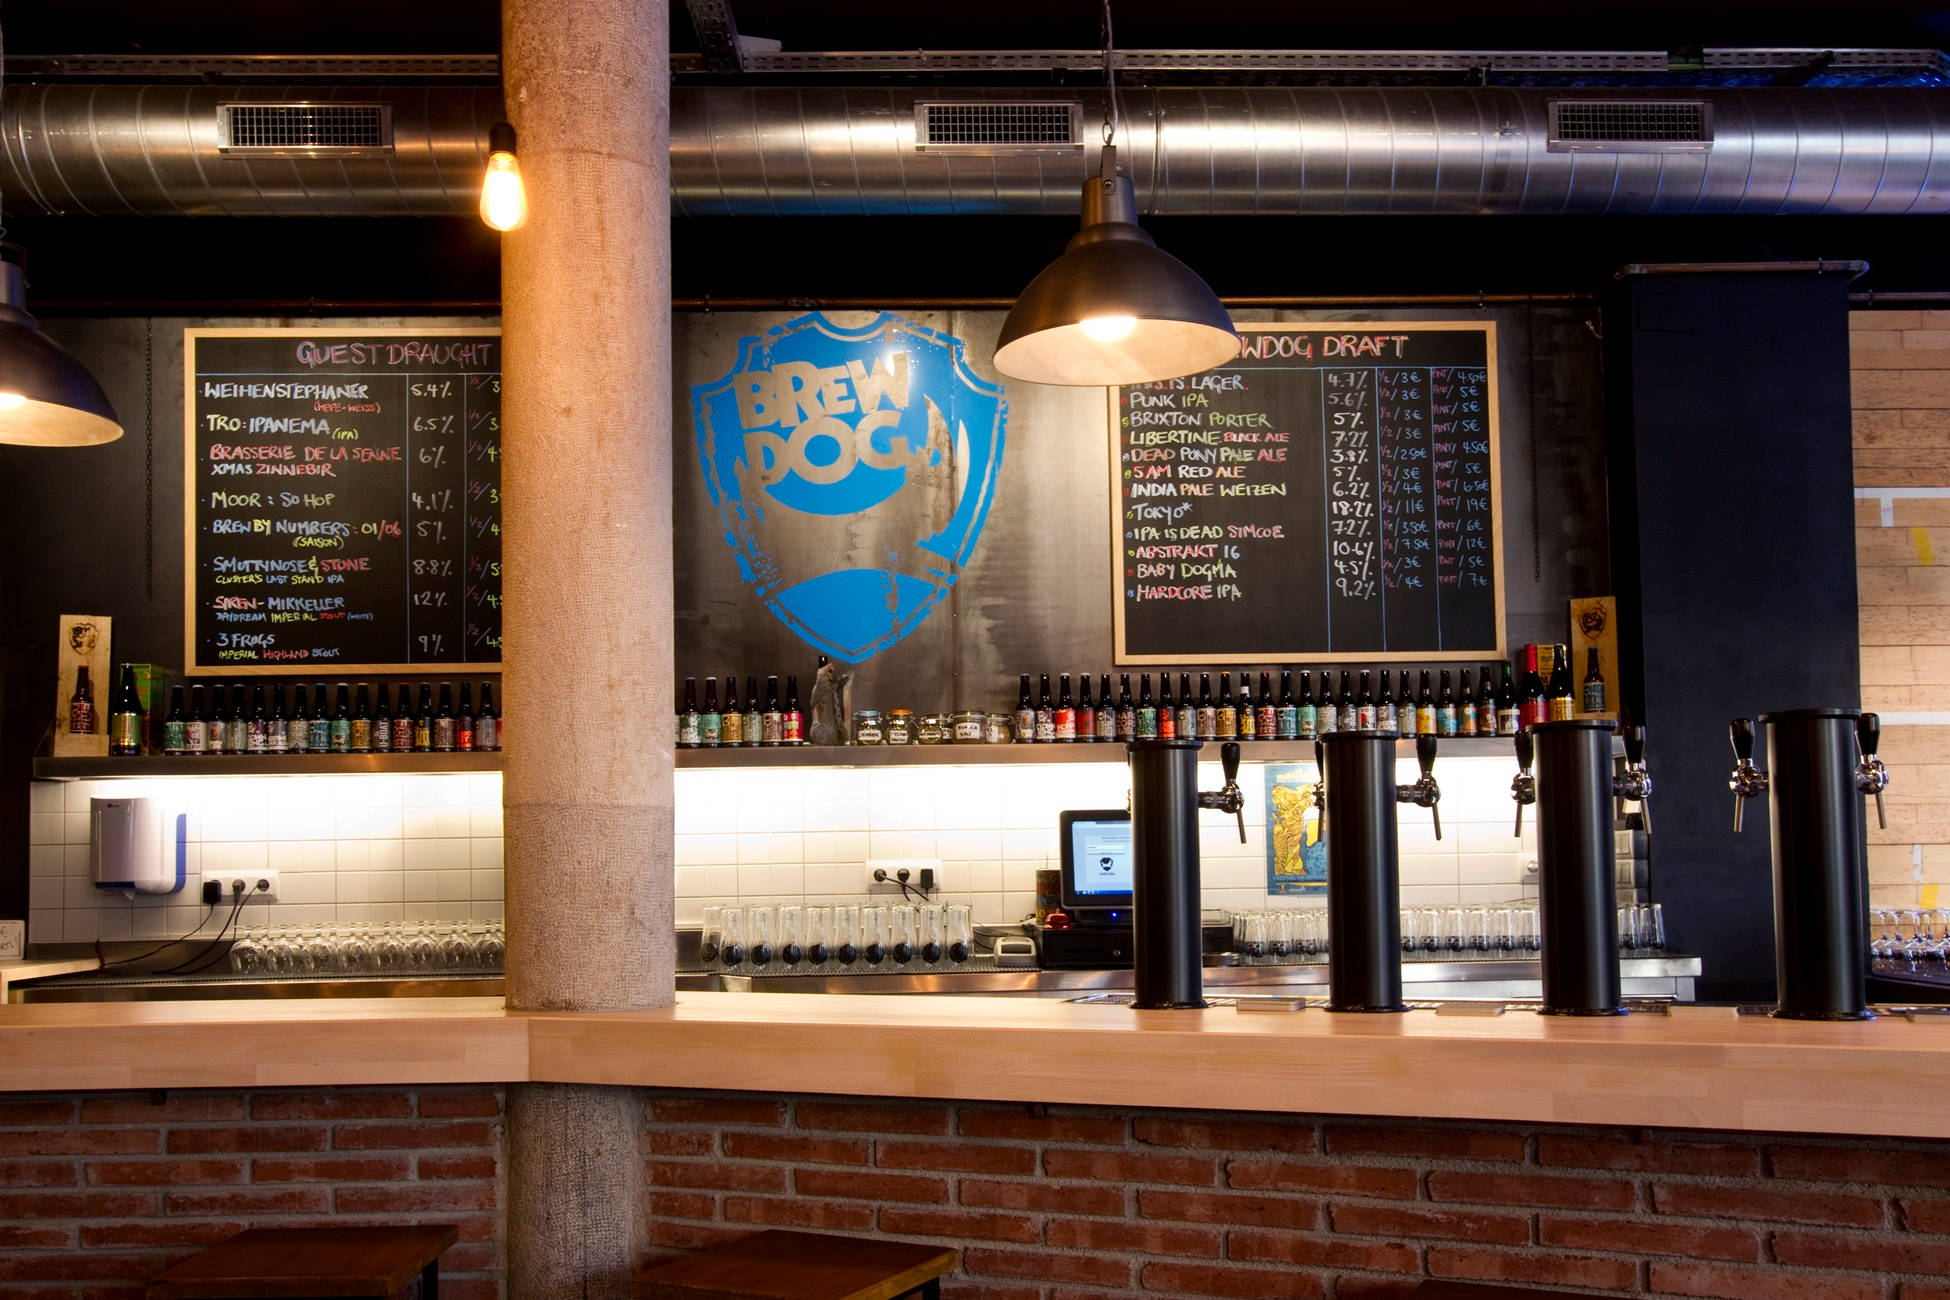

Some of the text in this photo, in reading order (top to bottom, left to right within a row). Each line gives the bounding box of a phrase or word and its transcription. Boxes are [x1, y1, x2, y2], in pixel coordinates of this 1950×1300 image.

[296, 341, 493, 368] GUEST DRAUGHT
[1237, 335, 1409, 361] WDOG DRAFT
[410, 380, 452, 398] 5.4%
[1328, 371, 1368, 390] 4.7%
[205, 382, 368, 400] WEIHENSTEPHANER
[733, 352, 909, 429] BREW
[1130, 391, 1209, 408] PUNK IPA
[1328, 391, 1368, 410] 5.6%
[413, 415, 454, 434] 6.5%
[1130, 411, 1272, 428] BRIXTON PORTER
[1334, 412, 1363, 428] 5%
[249, 417, 330, 434] IPANEMA
[332, 428, 358, 440] (IPA)
[1130, 430, 1290, 445] LIBERTINE BLACK ALE
[1331, 431, 1368, 447] 7.2%
[210, 444, 401, 462] BRASSERIE DE LA SENNE
[742, 410, 909, 484] DOG
[1131, 447, 1288, 464] DEAD PONY PALE ALE
[419, 447, 446, 469] 6%
[1330, 449, 1368, 464] 3.8%
[211, 463, 336, 477] XMAS ZINNEBIR
[1178, 465, 1213, 478] RED
[1215, 466, 1246, 478] ALE
[1333, 466, 1360, 481] 5%
[1130, 483, 1287, 498] INDIA PALE WEIZEN
[1333, 482, 1370, 499] 6.2%
[280, 492, 300, 507] SO
[304, 493, 336, 508] HOP
[412, 493, 453, 512] 4.1%
[1332, 501, 1374, 517] 18.2%
[213, 519, 251, 534] BREW
[253, 519, 271, 535] BY
[417, 521, 446, 543] 5%
[1134, 524, 1284, 541] IPA IS DEAD SIMCOE
[1331, 519, 1371, 537] 7.2%
[293, 535, 344, 550] (SAISON)
[1333, 541, 1375, 561] 10.6%
[1135, 544, 1240, 560] ABSTRAKT 16
[213, 556, 308, 573] SMUTTYNOSE
[321, 557, 372, 572] STONE
[412, 559, 452, 577] 8.8%
[1137, 559, 1237, 581] BABY DOGMA
[1334, 560, 1373, 580] 4.5%
[266, 575, 288, 584] LAST
[291, 575, 324, 585] STAND
[327, 575, 344, 584] IPA
[1137, 584, 1242, 601] HARDCORE IPA
[1336, 578, 1376, 600] 9.2%
[267, 596, 345, 612] MIKKELLER
[413, 592, 448, 607] 12%
[216, 612, 267, 622] DAYDREAM
[271, 613, 318, 623] IMPERIAL
[216, 633, 229, 646] 3
[418, 635, 444, 656] 9%
[219, 648, 340, 660] IMPERIAL HIGHLAND STOUT
